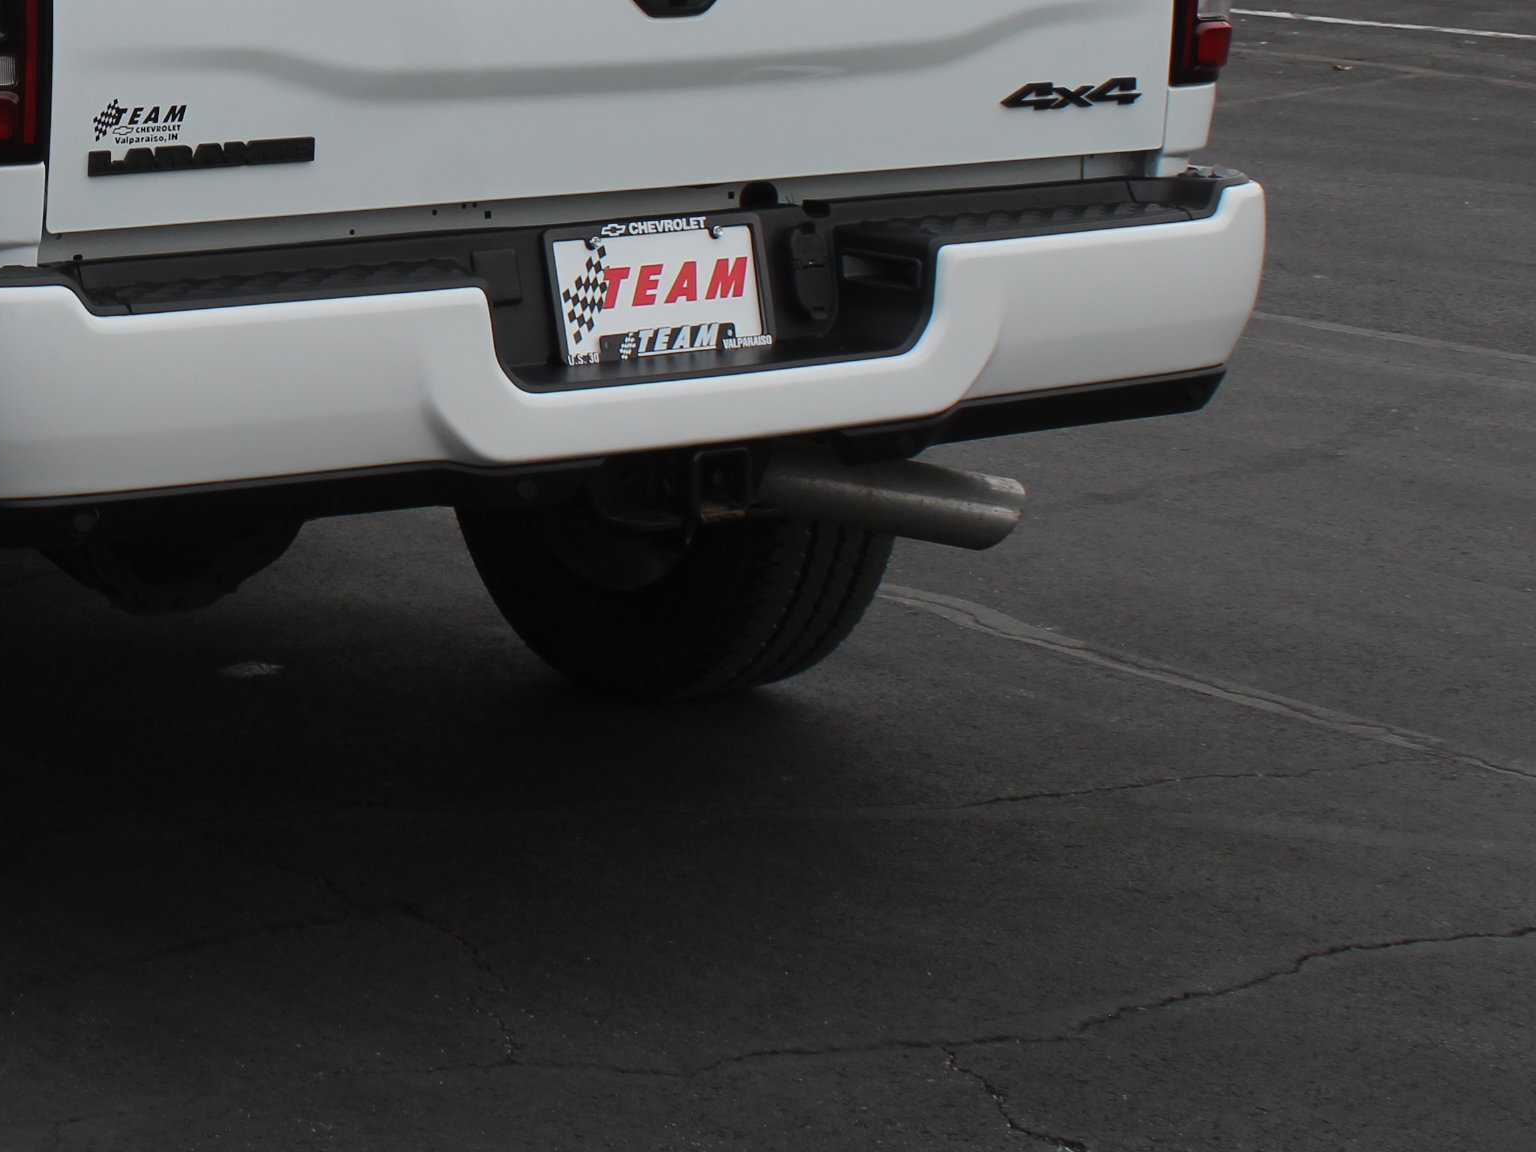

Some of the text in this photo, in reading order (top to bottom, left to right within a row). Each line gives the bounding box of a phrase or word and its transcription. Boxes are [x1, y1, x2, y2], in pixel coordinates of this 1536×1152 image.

[1000, 77, 1143, 110] 4x4
[114, 104, 187, 125] TEAM
[135, 124, 181, 134] CHEVROLET
[115, 133, 178, 145] Valparaiso, IN
[628, 216, 706, 235] CHEVROLET
[602, 256, 748, 309] TEAM
[637, 323, 719, 353] TEAM
[722, 334, 772, 349] VALPARAISO
[588, 352, 600, 364] 30
